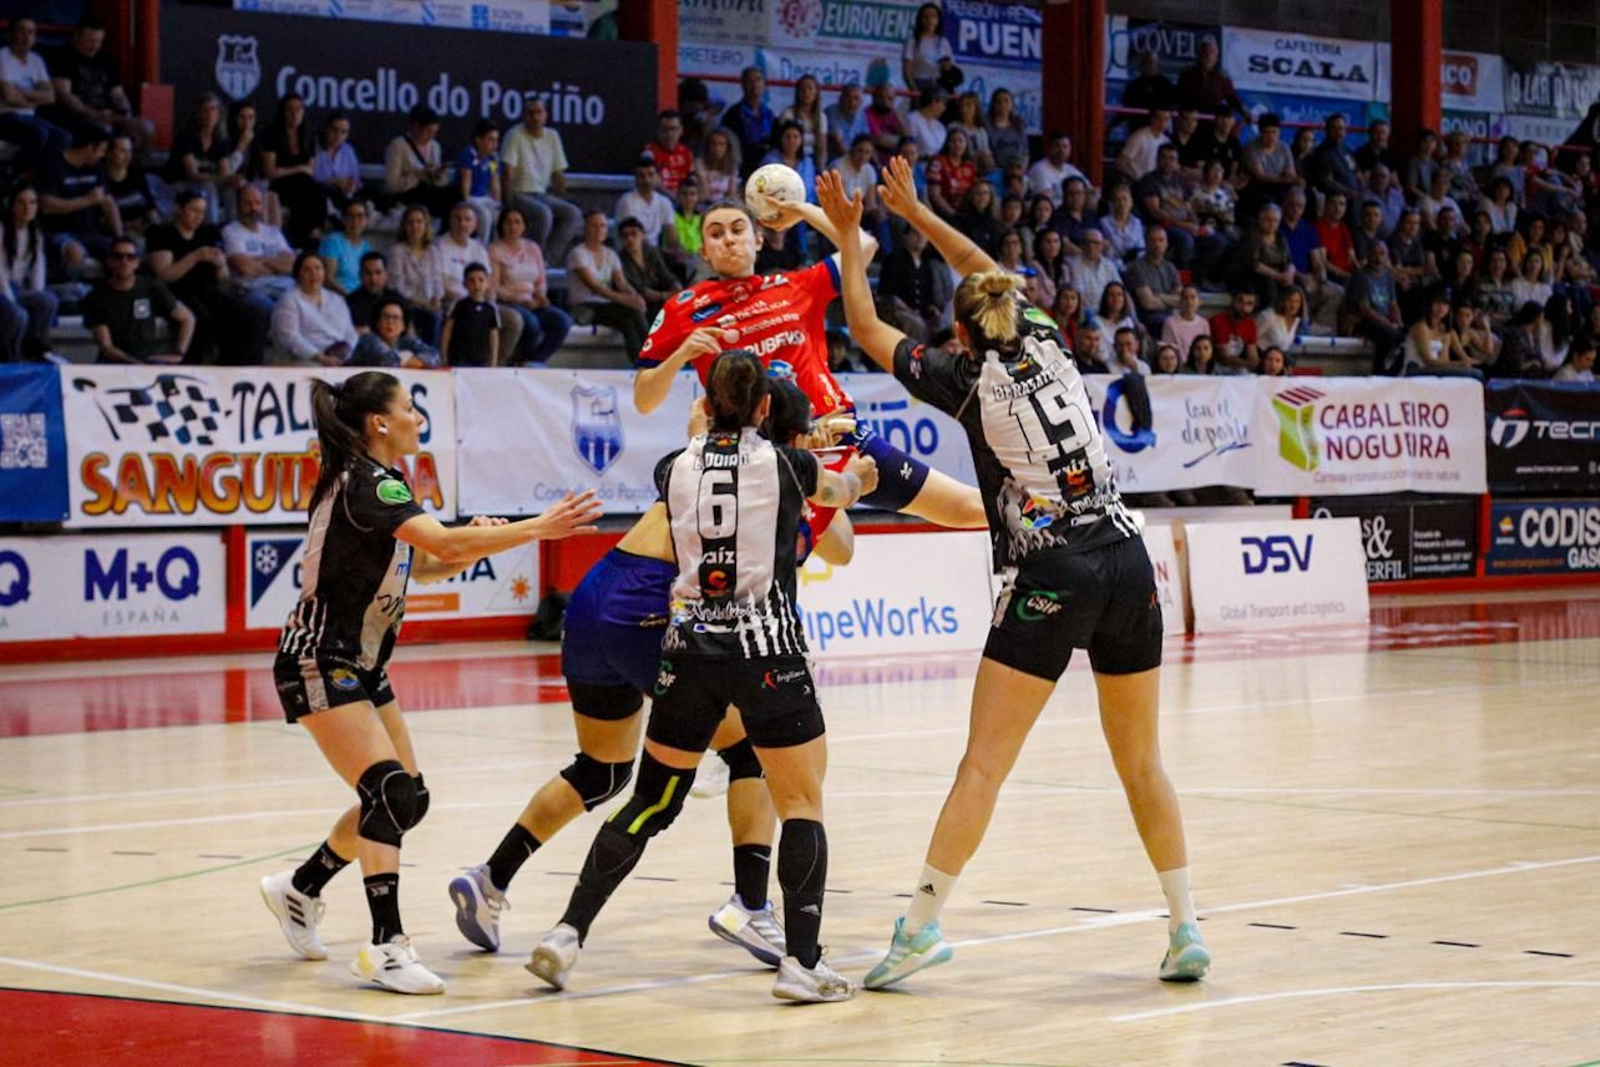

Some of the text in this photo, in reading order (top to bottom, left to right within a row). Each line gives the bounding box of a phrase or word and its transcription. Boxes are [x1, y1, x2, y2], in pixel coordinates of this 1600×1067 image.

[824, 3, 914, 44] EUROVEN
[1133, 28, 1197, 59] COVEL
[1247, 54, 1369, 83] SCALA
[276, 66, 419, 113] Concello
[428, 72, 470, 117] do
[232, 381, 431, 444] TALS
[1009, 376, 1093, 464] 15
[1320, 402, 1449, 430] CABALEIRO
[80, 440, 445, 515] SANGUIA
[698, 469, 738, 540] 6
[1366, 516, 1394, 559] &
[1519, 507, 1600, 548] CODIS
[84, 546, 200, 602] M+Q
[1241, 534, 1314, 575] DSV
[1367, 561, 1407, 580] ERFIL
[102, 607, 180, 627] ESPAÑA
[1219, 600, 1346, 619] Global Transport and Logistics
